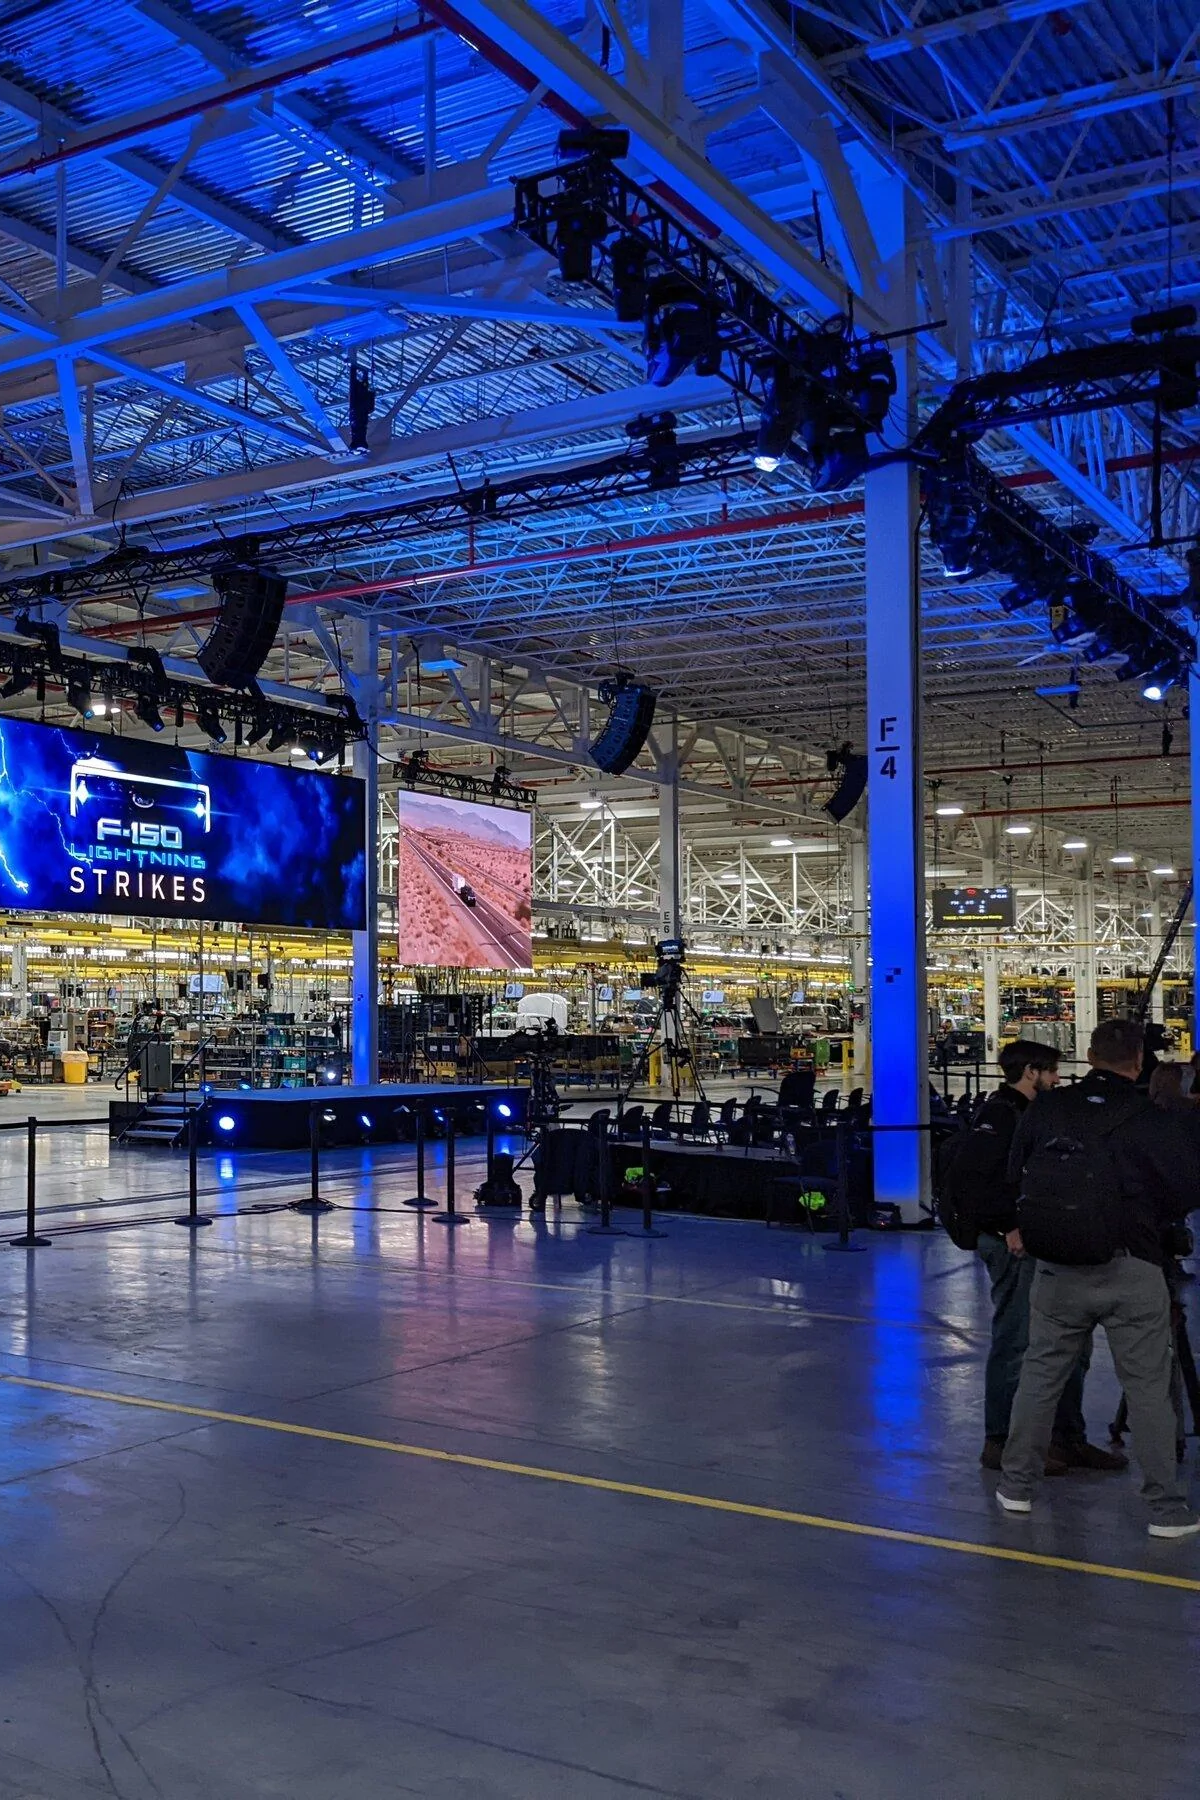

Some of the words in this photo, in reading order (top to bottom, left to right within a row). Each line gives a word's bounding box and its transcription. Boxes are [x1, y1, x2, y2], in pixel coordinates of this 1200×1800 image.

[880, 717, 897, 741] F
[880, 756, 897, 779] 4
[69, 843, 206, 869] LIGHTNING
[69, 866, 206, 902] STRIKES
